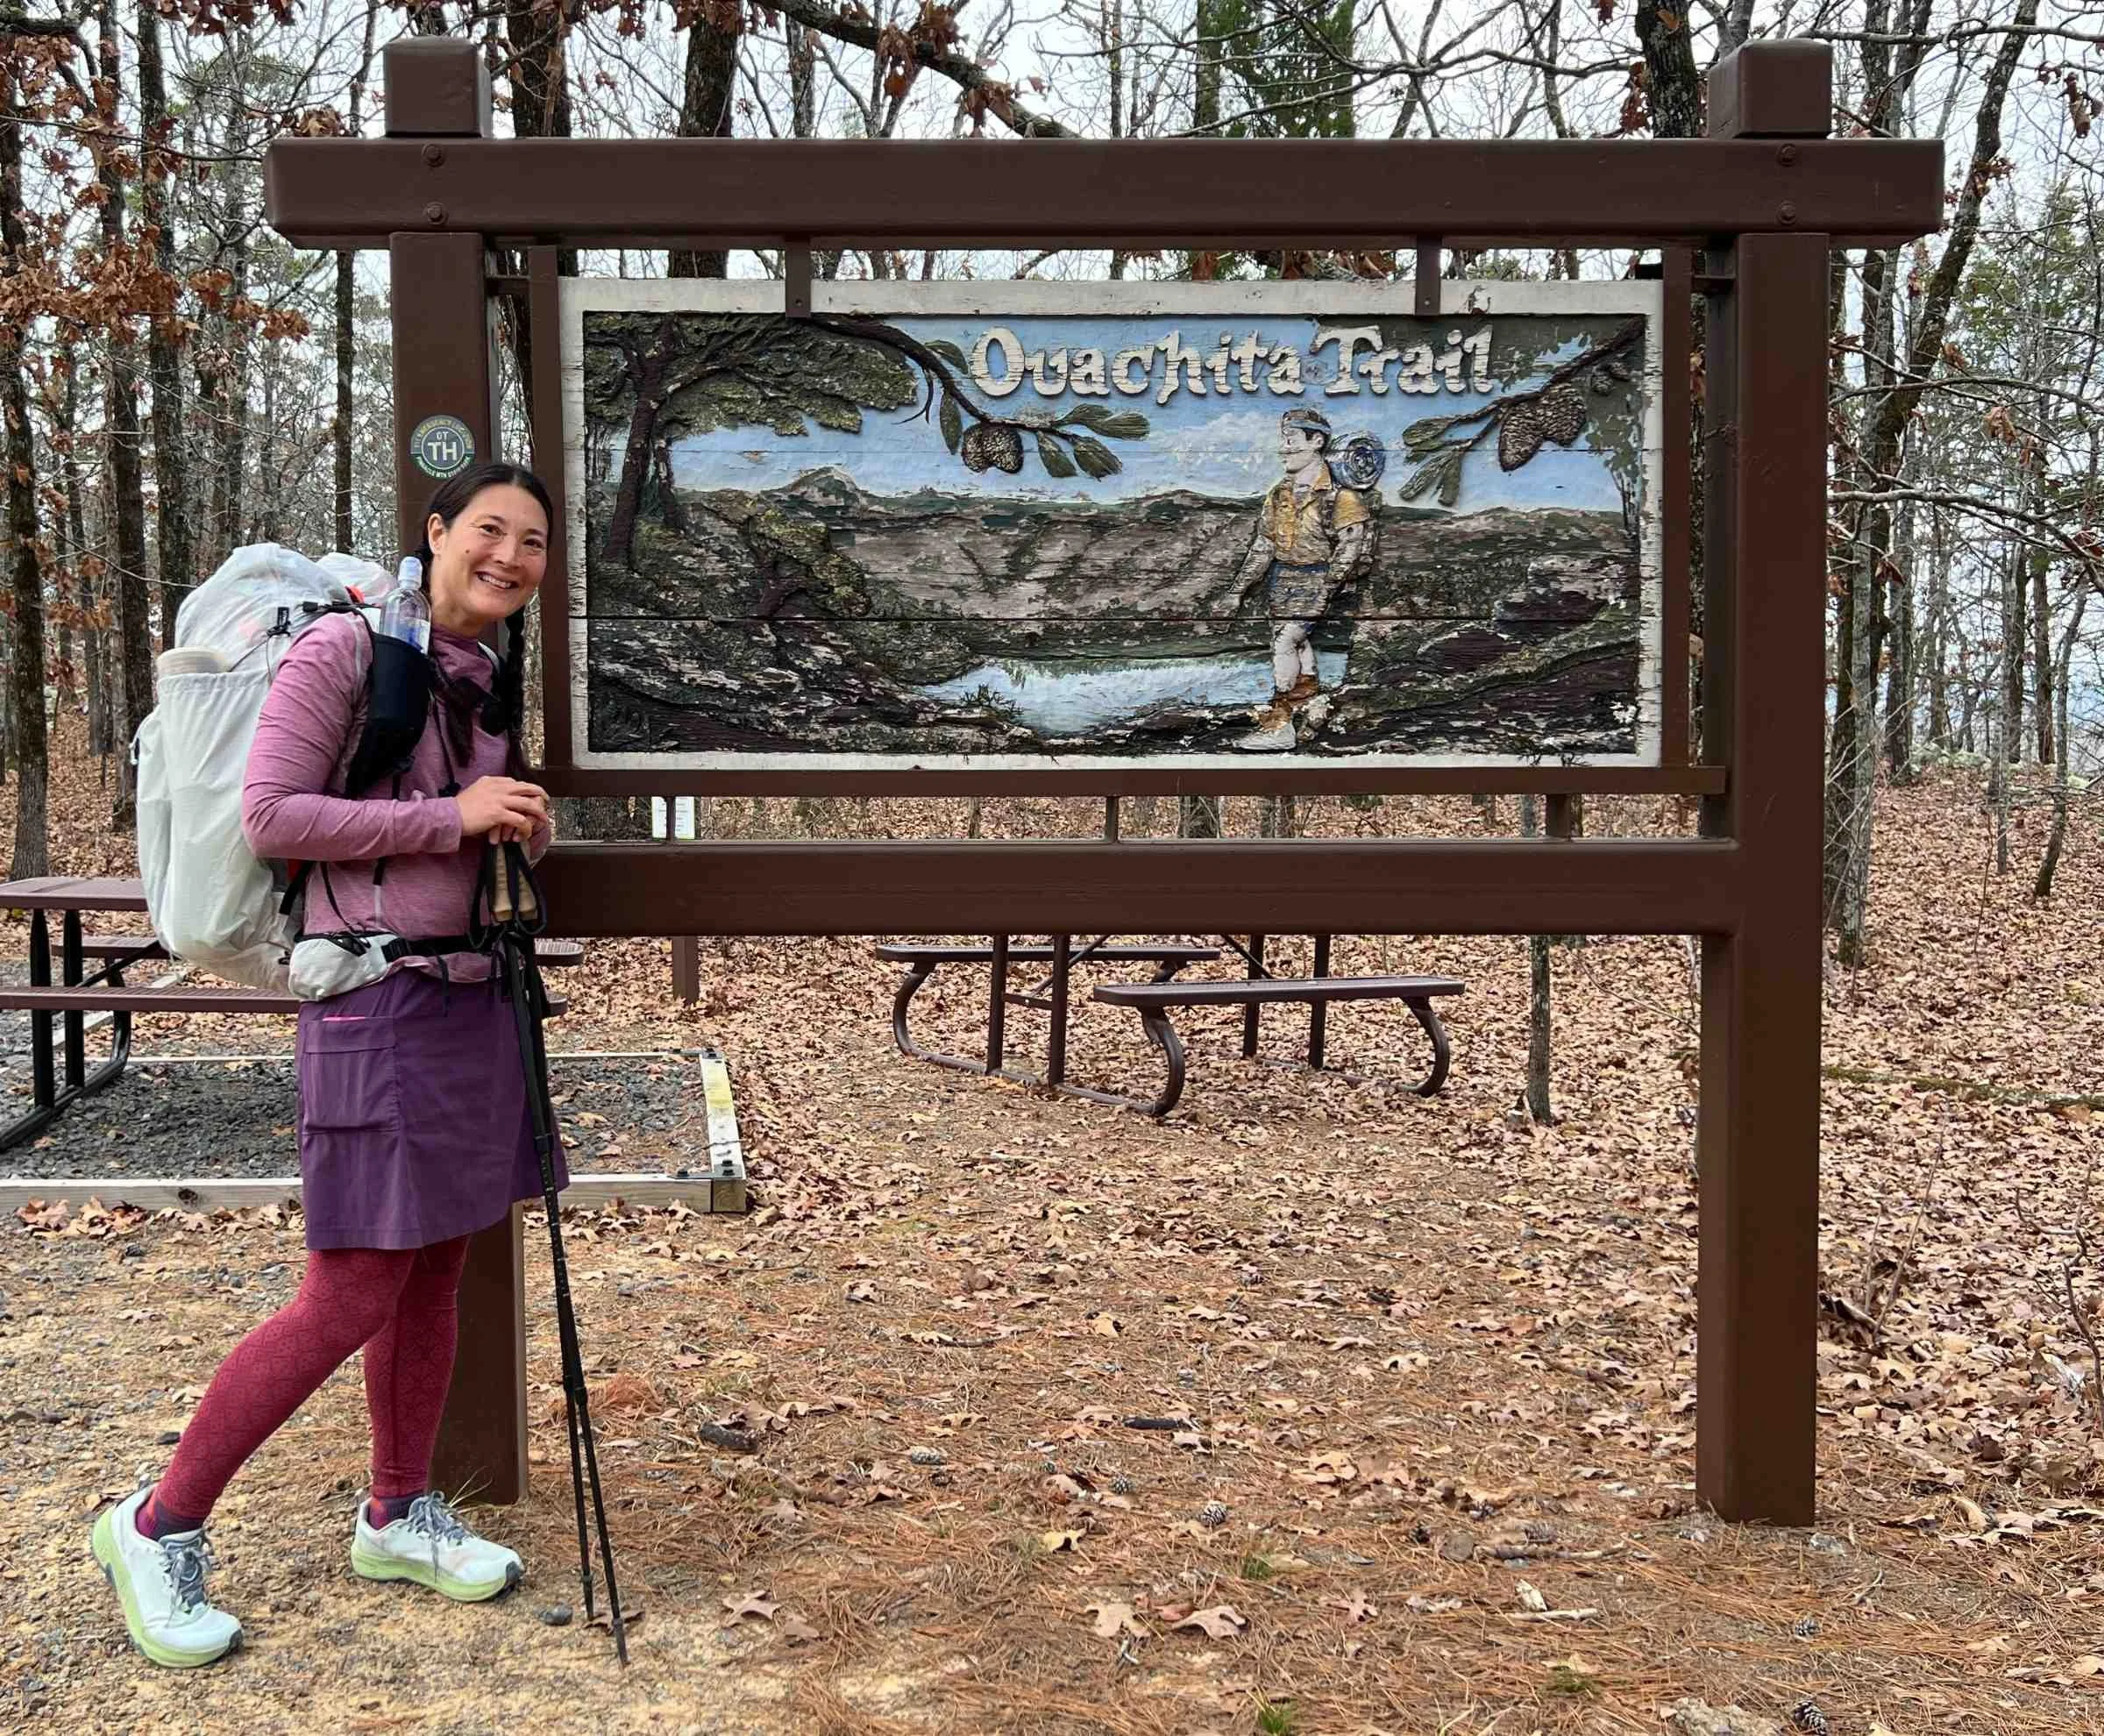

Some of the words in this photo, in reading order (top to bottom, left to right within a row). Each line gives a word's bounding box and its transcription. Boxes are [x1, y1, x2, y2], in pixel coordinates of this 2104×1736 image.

[970, 326, 1305, 404] Ouachita
[1311, 324, 1493, 395] Trail
[427, 441, 457, 461] TH
